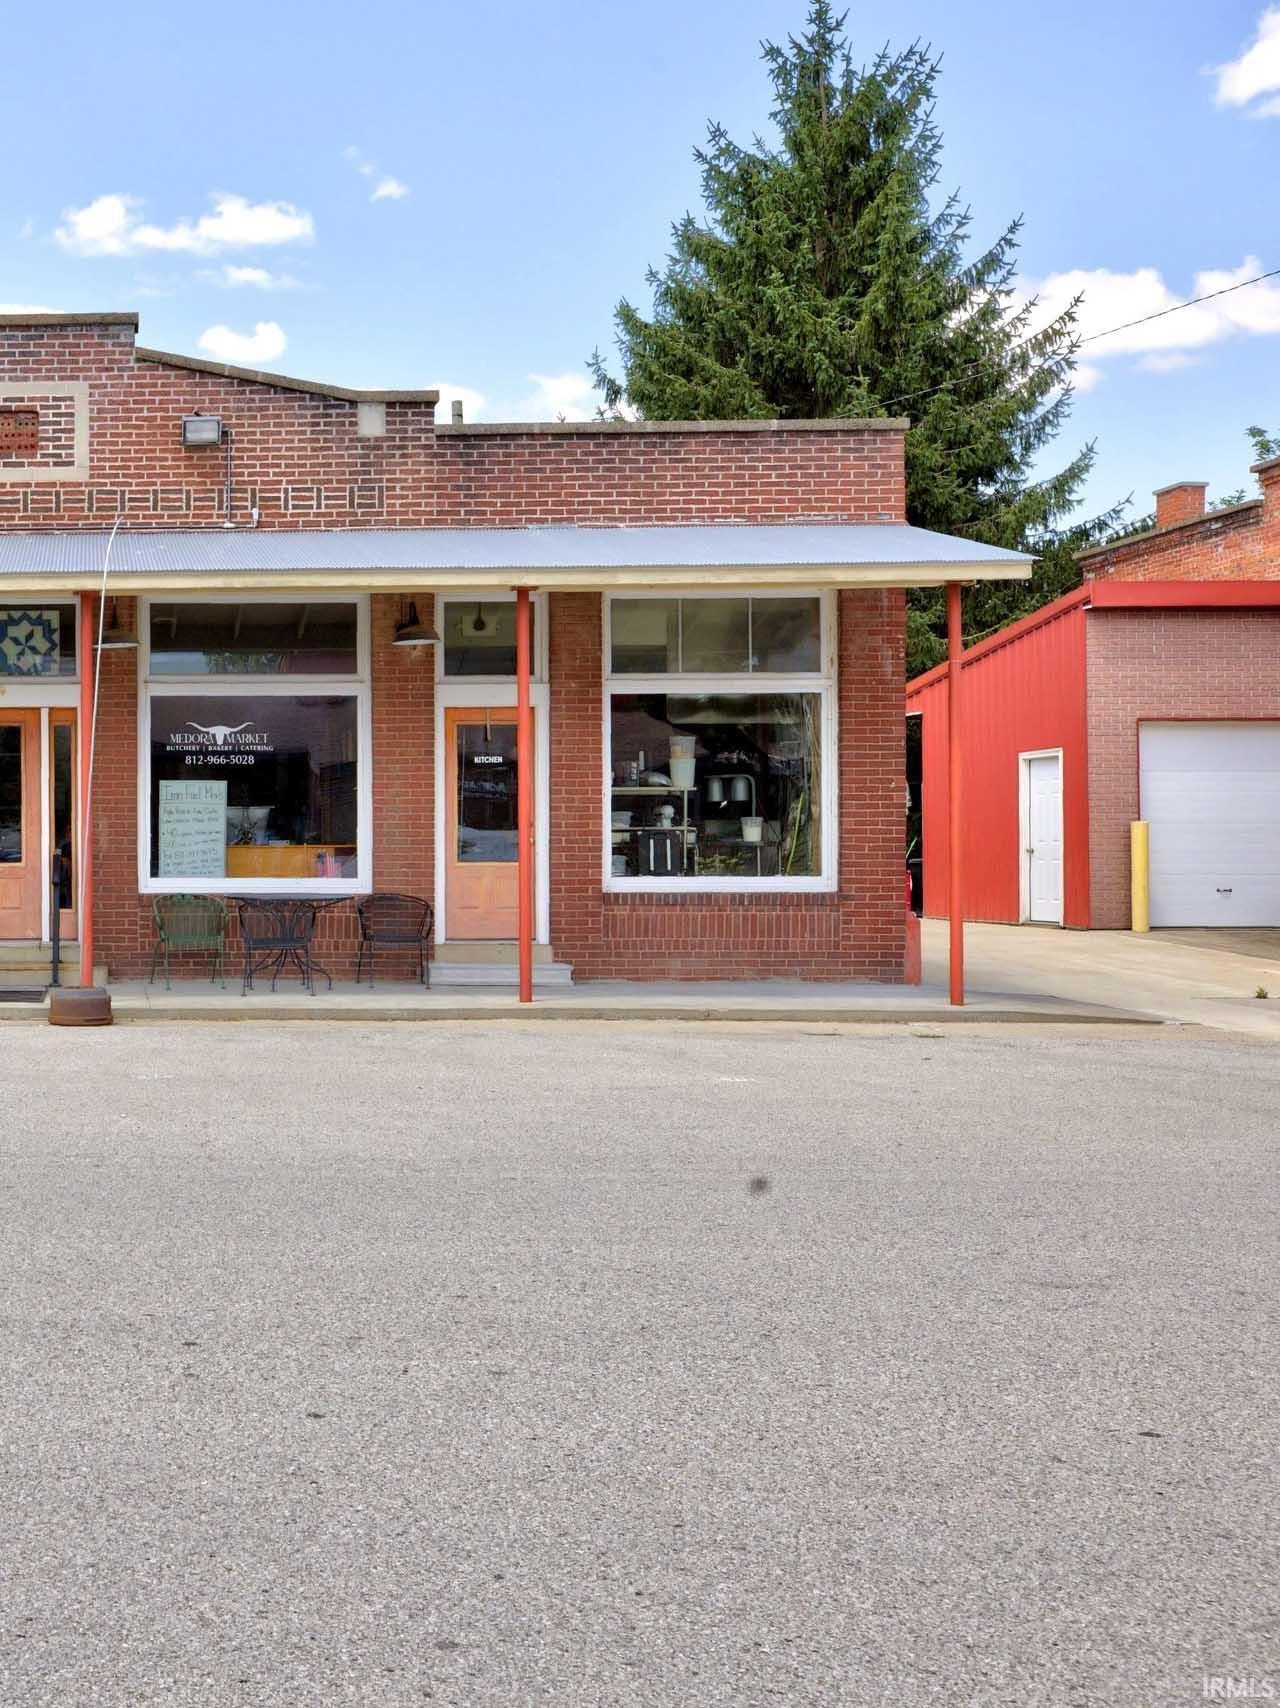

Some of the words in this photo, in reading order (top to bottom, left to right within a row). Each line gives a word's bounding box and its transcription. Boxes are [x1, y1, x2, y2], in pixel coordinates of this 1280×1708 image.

[169, 733, 214, 744] MEDORA
[223, 733, 269, 744] MARKET
[185, 755, 255, 765] 812-966-5028
[474, 756, 503, 764] KITCHEN
